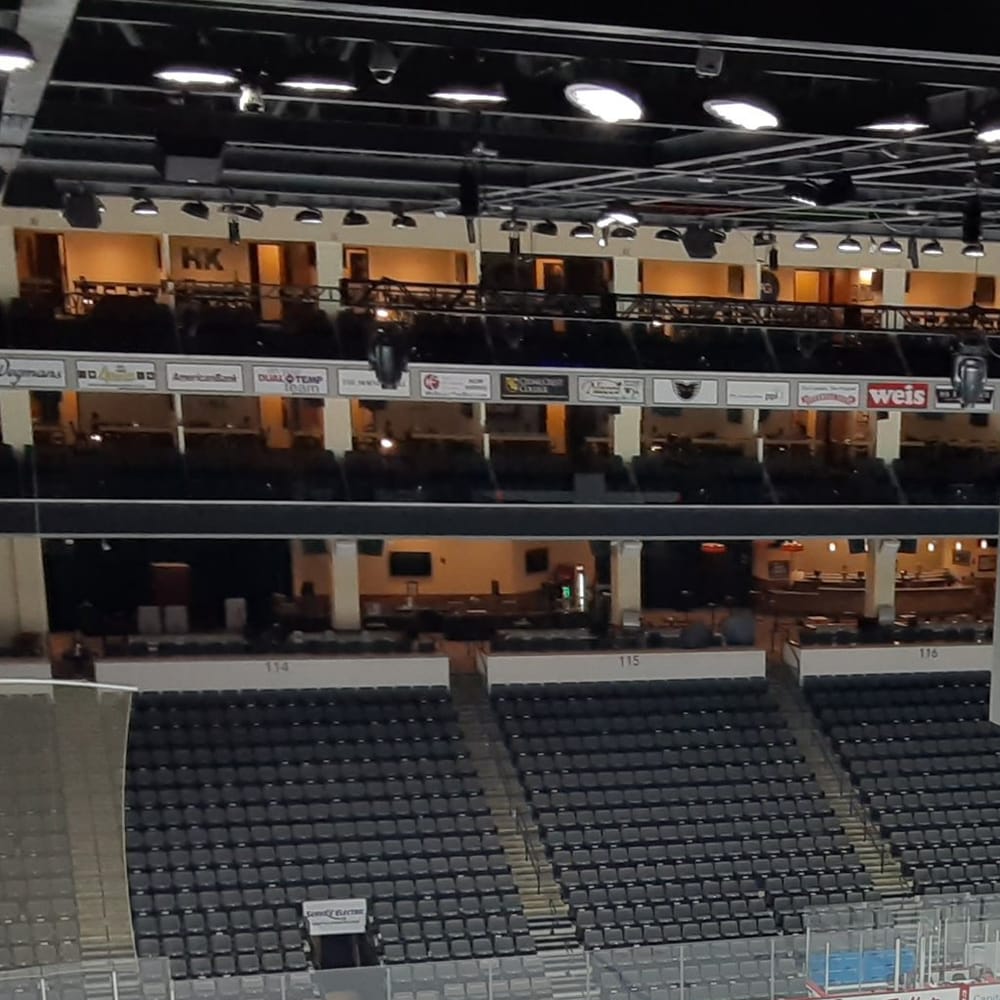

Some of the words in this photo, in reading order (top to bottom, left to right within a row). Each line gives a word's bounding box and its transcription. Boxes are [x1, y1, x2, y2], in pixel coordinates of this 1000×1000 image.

[295, 376, 323, 384] TEMP
[869, 385, 927, 406] weis
[919, 648, 938, 658] 116
[619, 655, 640, 667] 115
